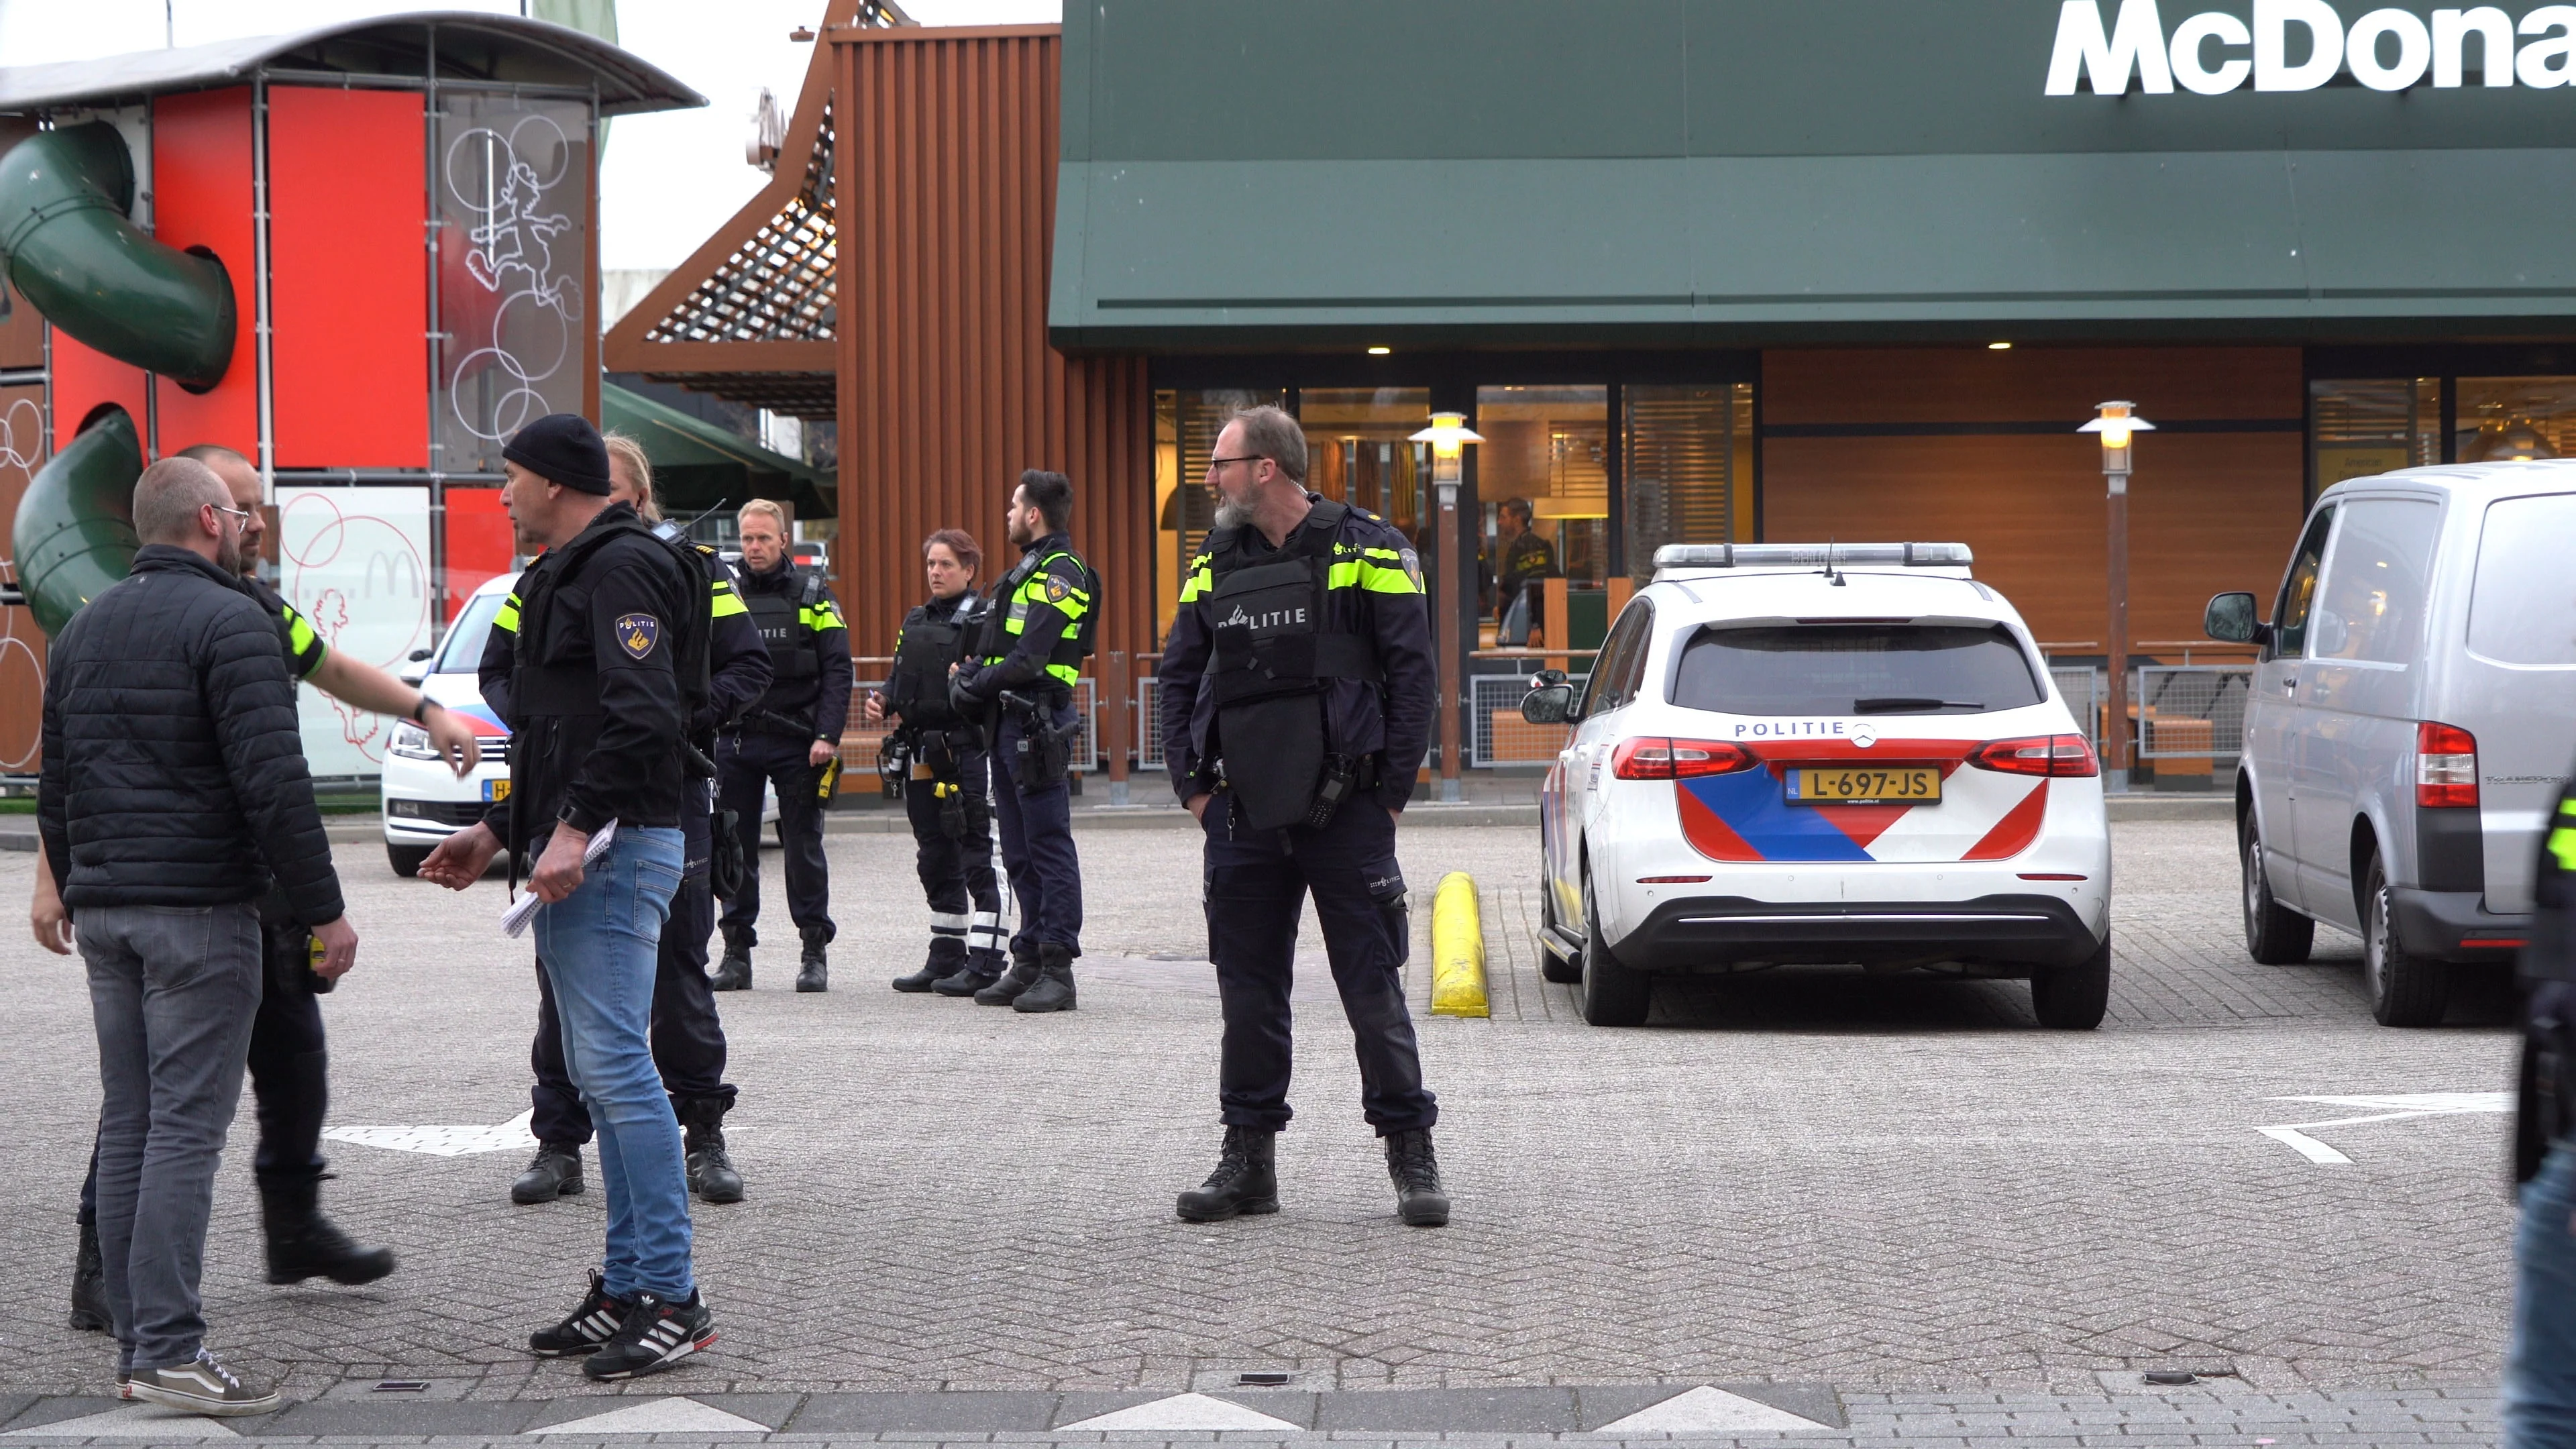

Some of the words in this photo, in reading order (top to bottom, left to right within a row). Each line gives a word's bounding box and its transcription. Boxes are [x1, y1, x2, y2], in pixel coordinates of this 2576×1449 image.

[2045, 0, 2576, 95] McDona
[619, 617, 655, 629] POLITIE
[1735, 722, 1843, 737] POLITIE
[1813, 773, 1928, 796] L-697-JS
